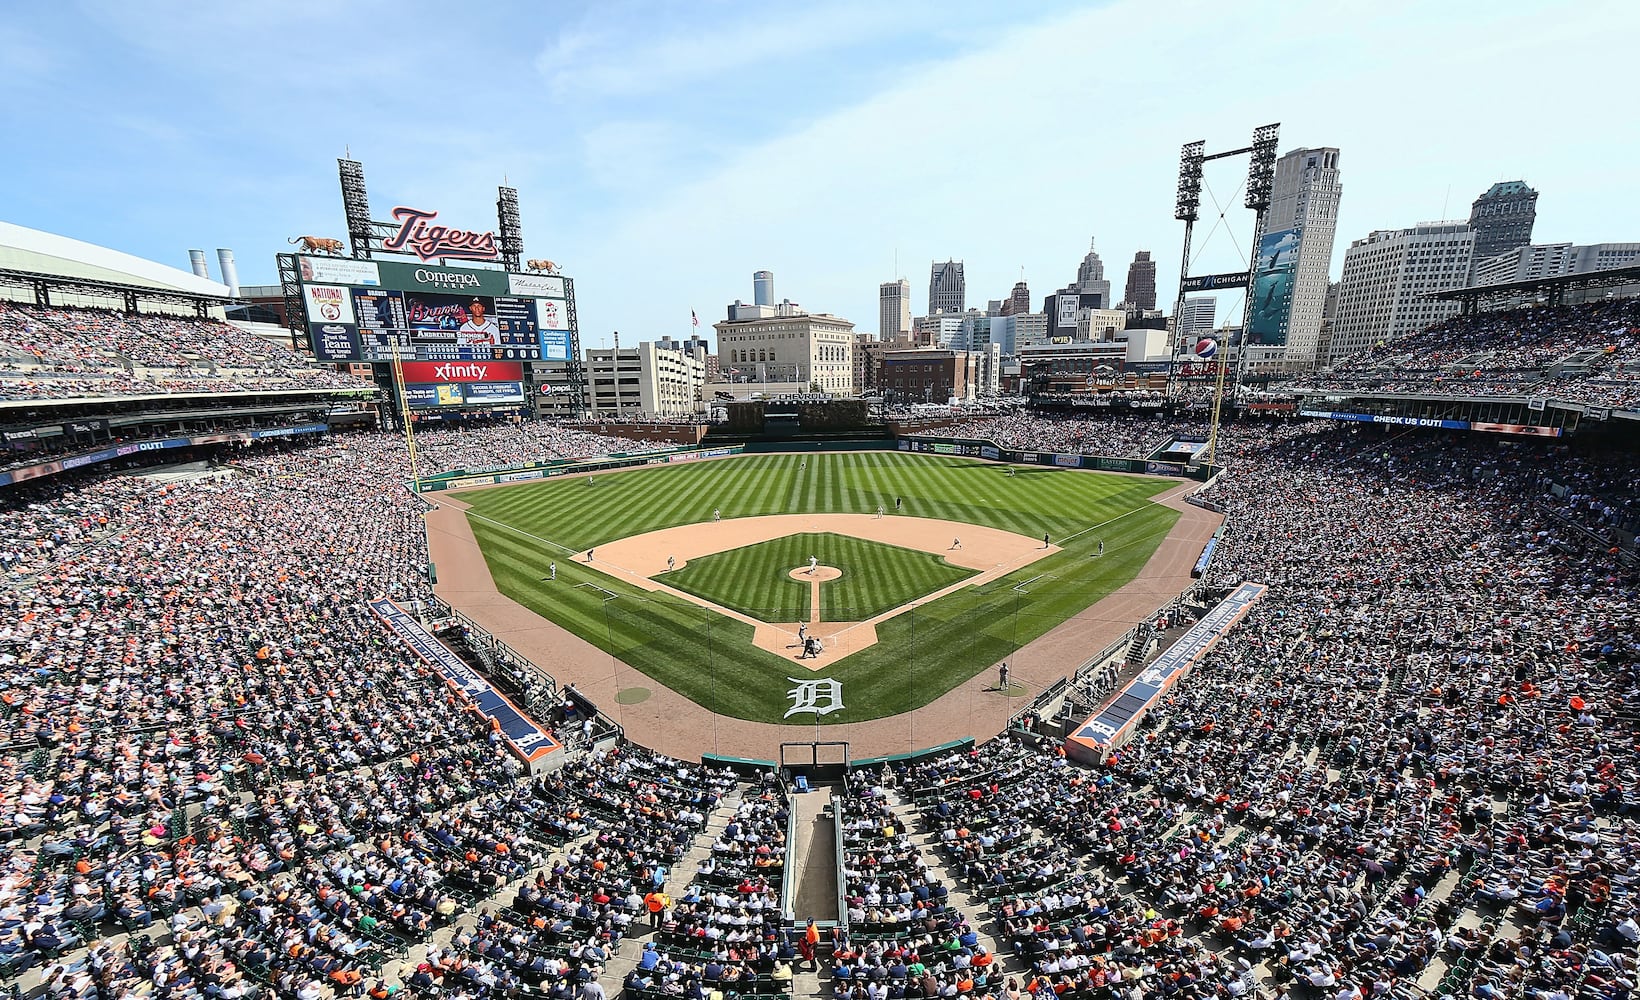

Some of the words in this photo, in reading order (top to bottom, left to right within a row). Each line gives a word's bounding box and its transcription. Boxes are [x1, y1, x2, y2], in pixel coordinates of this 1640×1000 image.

[384, 206, 499, 262] Tigers
[1203, 275, 1248, 287] MICHIGAN
[312, 288, 343, 299] NATIONAL
[322, 339, 351, 348] Team
[507, 350, 514, 358] 0
[520, 350, 526, 358] 0
[1373, 415, 1403, 424] CHECK
[1419, 419, 1442, 427] OUT!
[139, 442, 164, 451] OUT!
